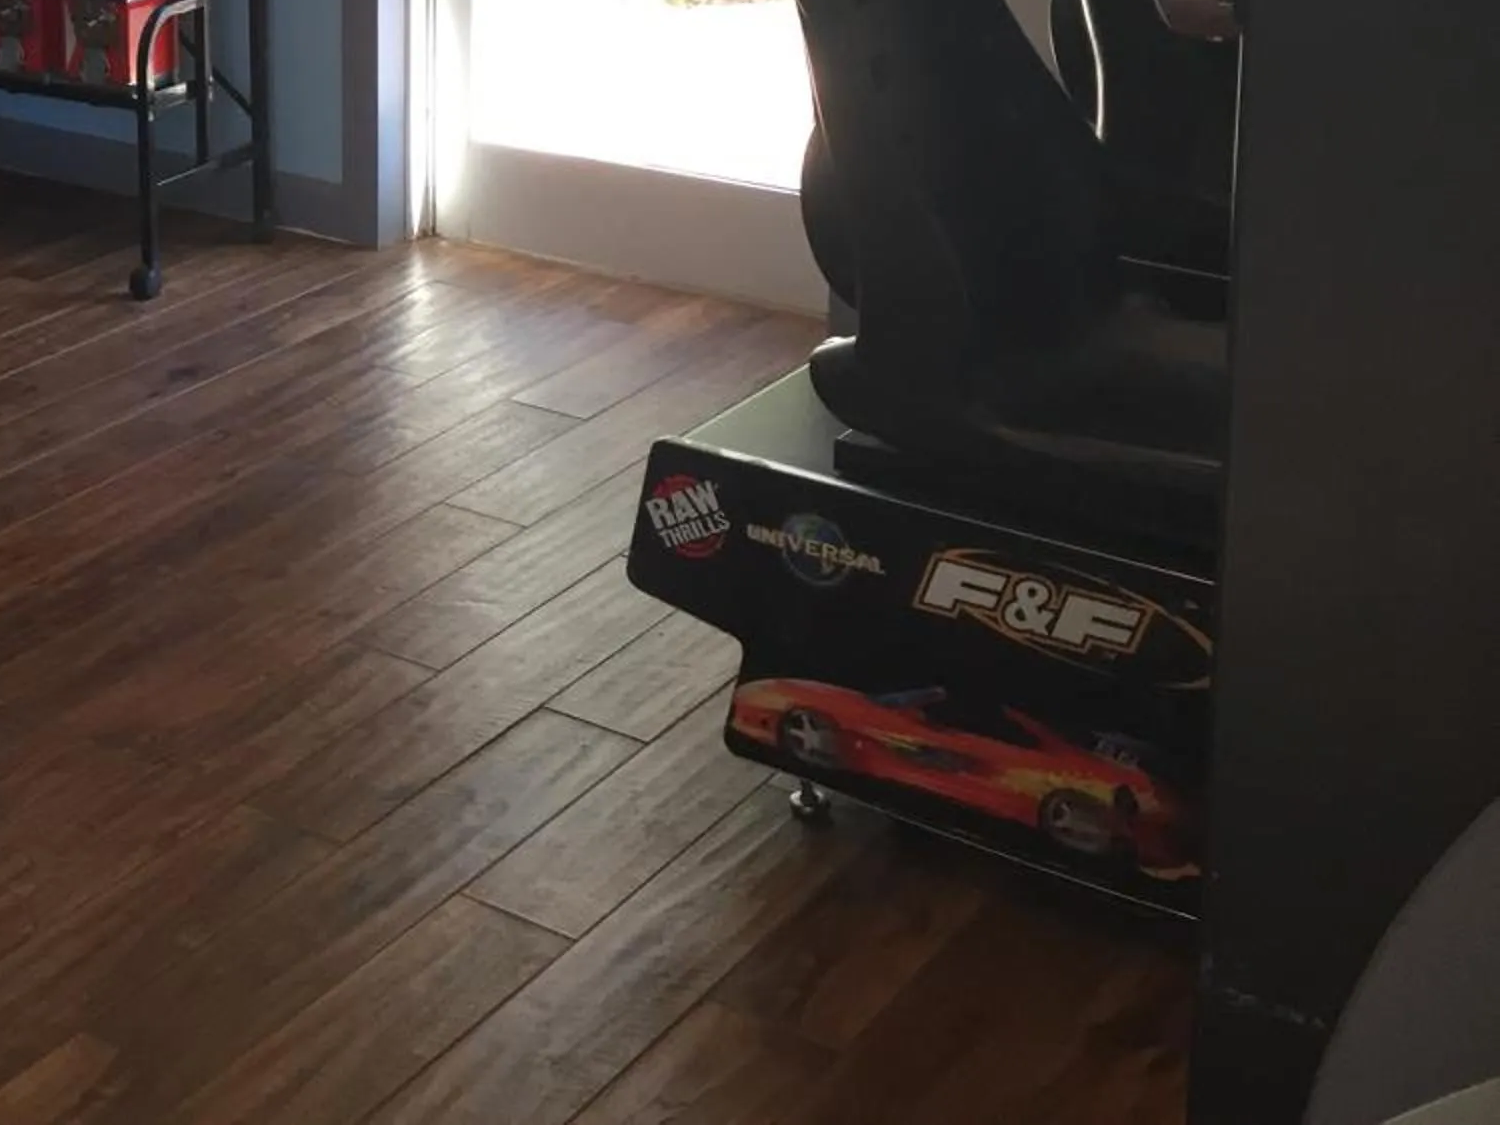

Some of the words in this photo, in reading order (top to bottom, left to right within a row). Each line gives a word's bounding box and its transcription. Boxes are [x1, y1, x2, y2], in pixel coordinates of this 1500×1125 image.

[644, 480, 719, 529] RAW
[658, 511, 731, 547] THRILLS
[745, 522, 886, 576] UNIVERSAL
[918, 556, 1151, 653] F&F
